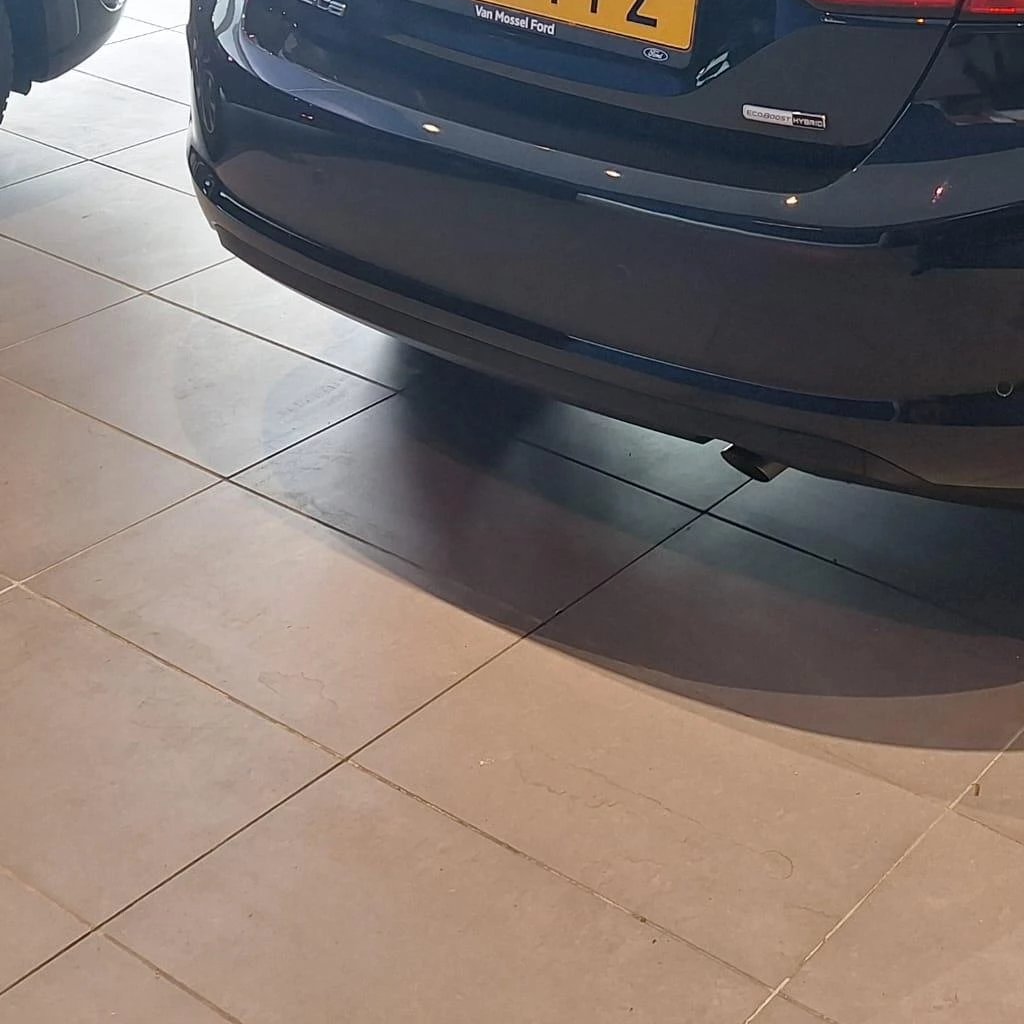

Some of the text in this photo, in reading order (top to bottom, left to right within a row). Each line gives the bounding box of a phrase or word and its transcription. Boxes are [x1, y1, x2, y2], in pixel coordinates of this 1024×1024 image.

[475, 5, 555, 35] Van Mossel Ford
